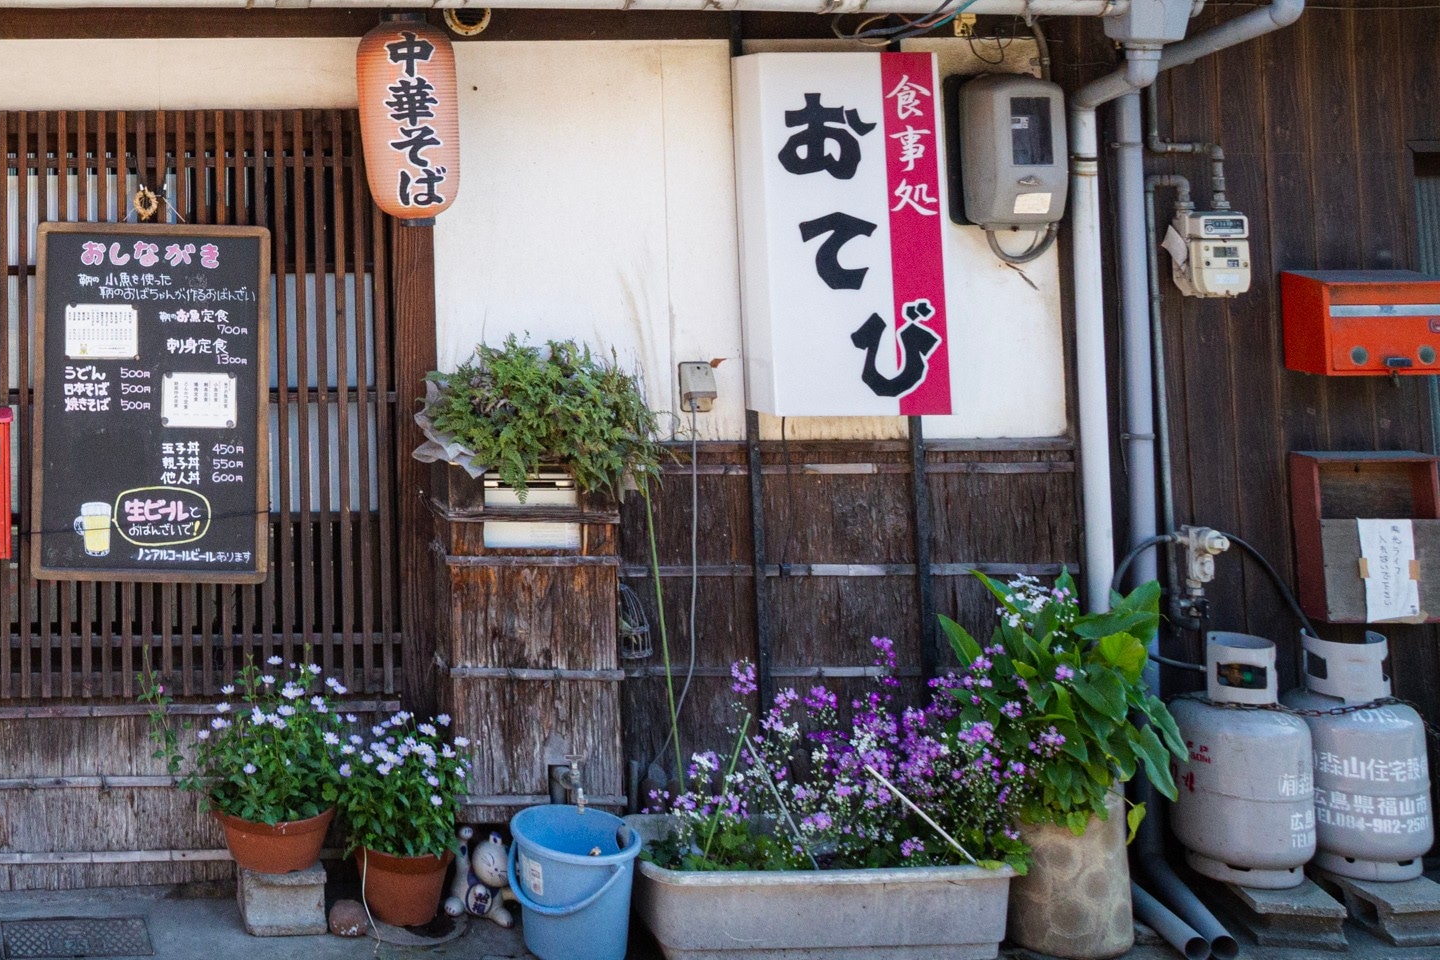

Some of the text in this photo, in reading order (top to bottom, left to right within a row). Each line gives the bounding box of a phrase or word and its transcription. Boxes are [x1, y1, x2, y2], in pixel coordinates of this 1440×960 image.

[385, 30, 448, 206] 中華そば
[885, 75, 939, 216] 食事処
[778, 92, 942, 398] おてび
[81, 241, 220, 269] おしながき
[217, 324, 248, 335] 700円
[166, 337, 229, 354] 刺身定食
[216, 354, 248, 365] 1300円
[64, 365, 151, 380] うどん 500円
[63, 382, 151, 396] 日本そば 500円
[64, 397, 151, 412] 焼きそば 500円
[162, 441, 244, 455] 玉子丼 450円
[162, 456, 244, 470] 親子丼 550円
[160, 471, 244, 485] 他人丼 600円
[124, 498, 201, 521] 生ビールと
[137, 548, 252, 563] ノンアルコールビールあります
